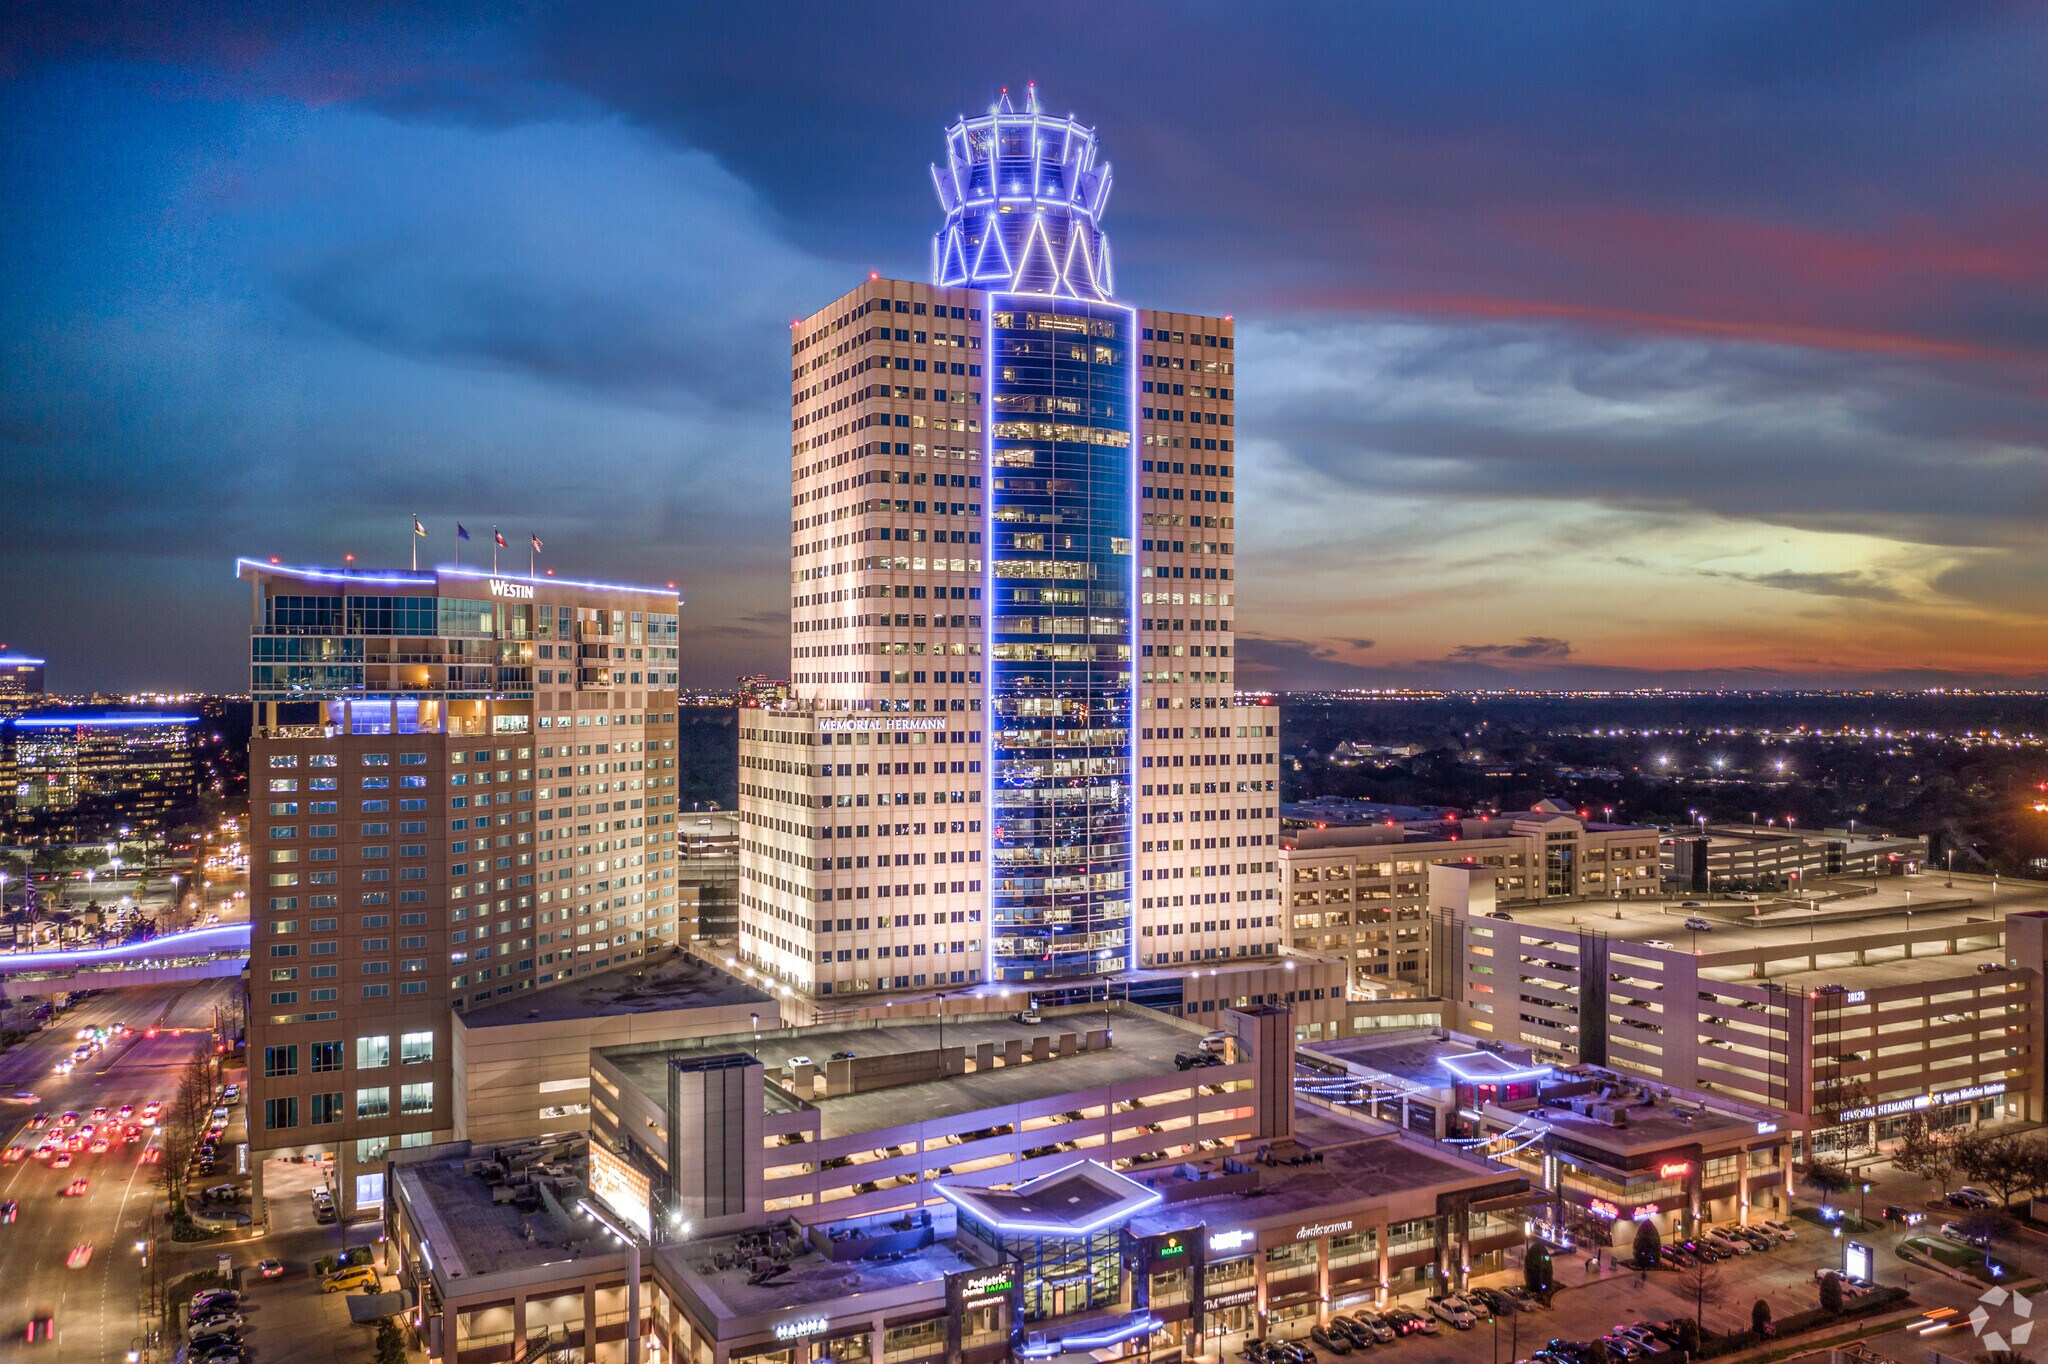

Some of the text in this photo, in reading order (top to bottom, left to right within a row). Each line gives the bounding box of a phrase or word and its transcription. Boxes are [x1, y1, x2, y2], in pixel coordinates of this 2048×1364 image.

[489, 579, 534, 599] WESTIN
[819, 719, 946, 731] MEMORIAL HERMANN
[1847, 990, 1866, 1003] 10125
[1878, 1099, 1913, 1116] HERMANN
[1943, 1092, 1960, 1105] Sports
[1960, 1086, 1984, 1100] Medicine
[1984, 1082, 2006, 1096] Institute
[123, 1217, 144, 1229] ONLY
[1296, 1223, 1323, 1240] charles
[1161, 1245, 1184, 1256] ROLEX
[967, 1273, 1007, 1290] Pediatric
[985, 1280, 1012, 1293] SAFARI
[776, 1318, 828, 1339] HANNA
